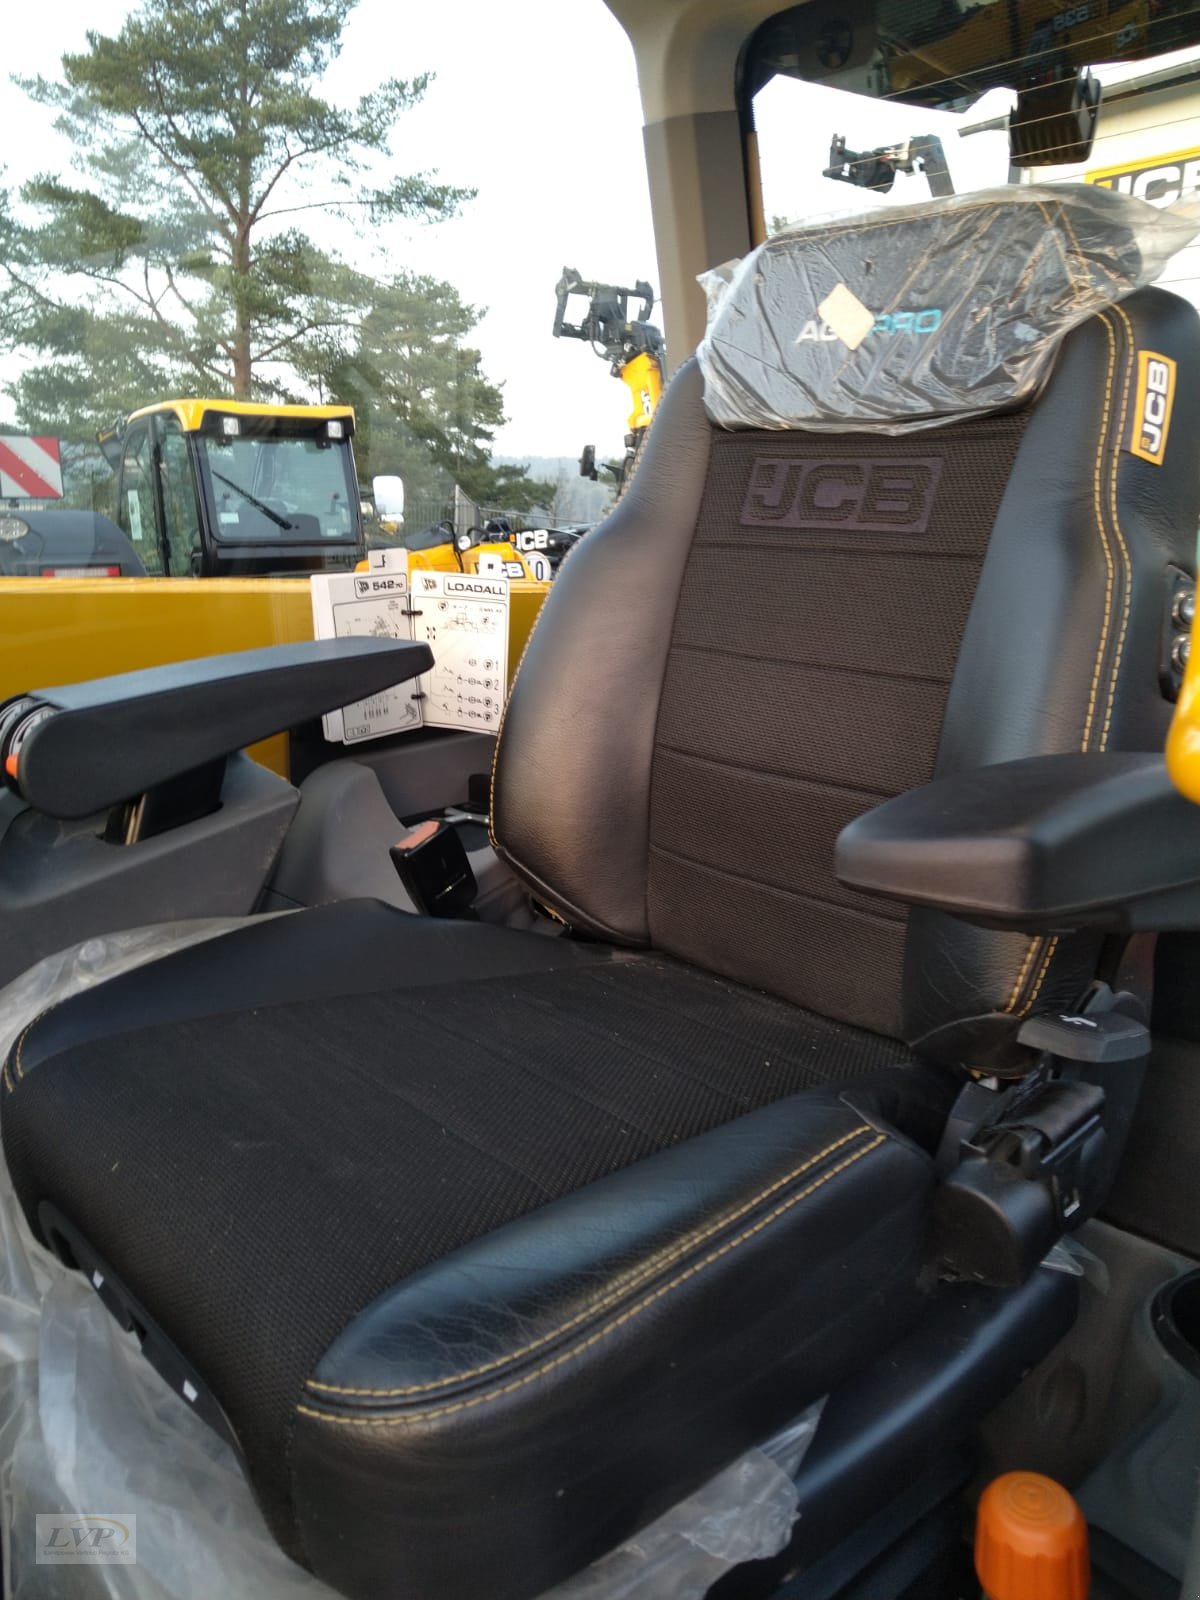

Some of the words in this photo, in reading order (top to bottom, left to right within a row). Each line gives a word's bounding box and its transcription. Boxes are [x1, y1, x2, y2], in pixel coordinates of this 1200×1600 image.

[1139, 361, 1169, 453] JCB
[748, 464, 930, 524] JCB
[448, 582, 506, 596] LOADALL
